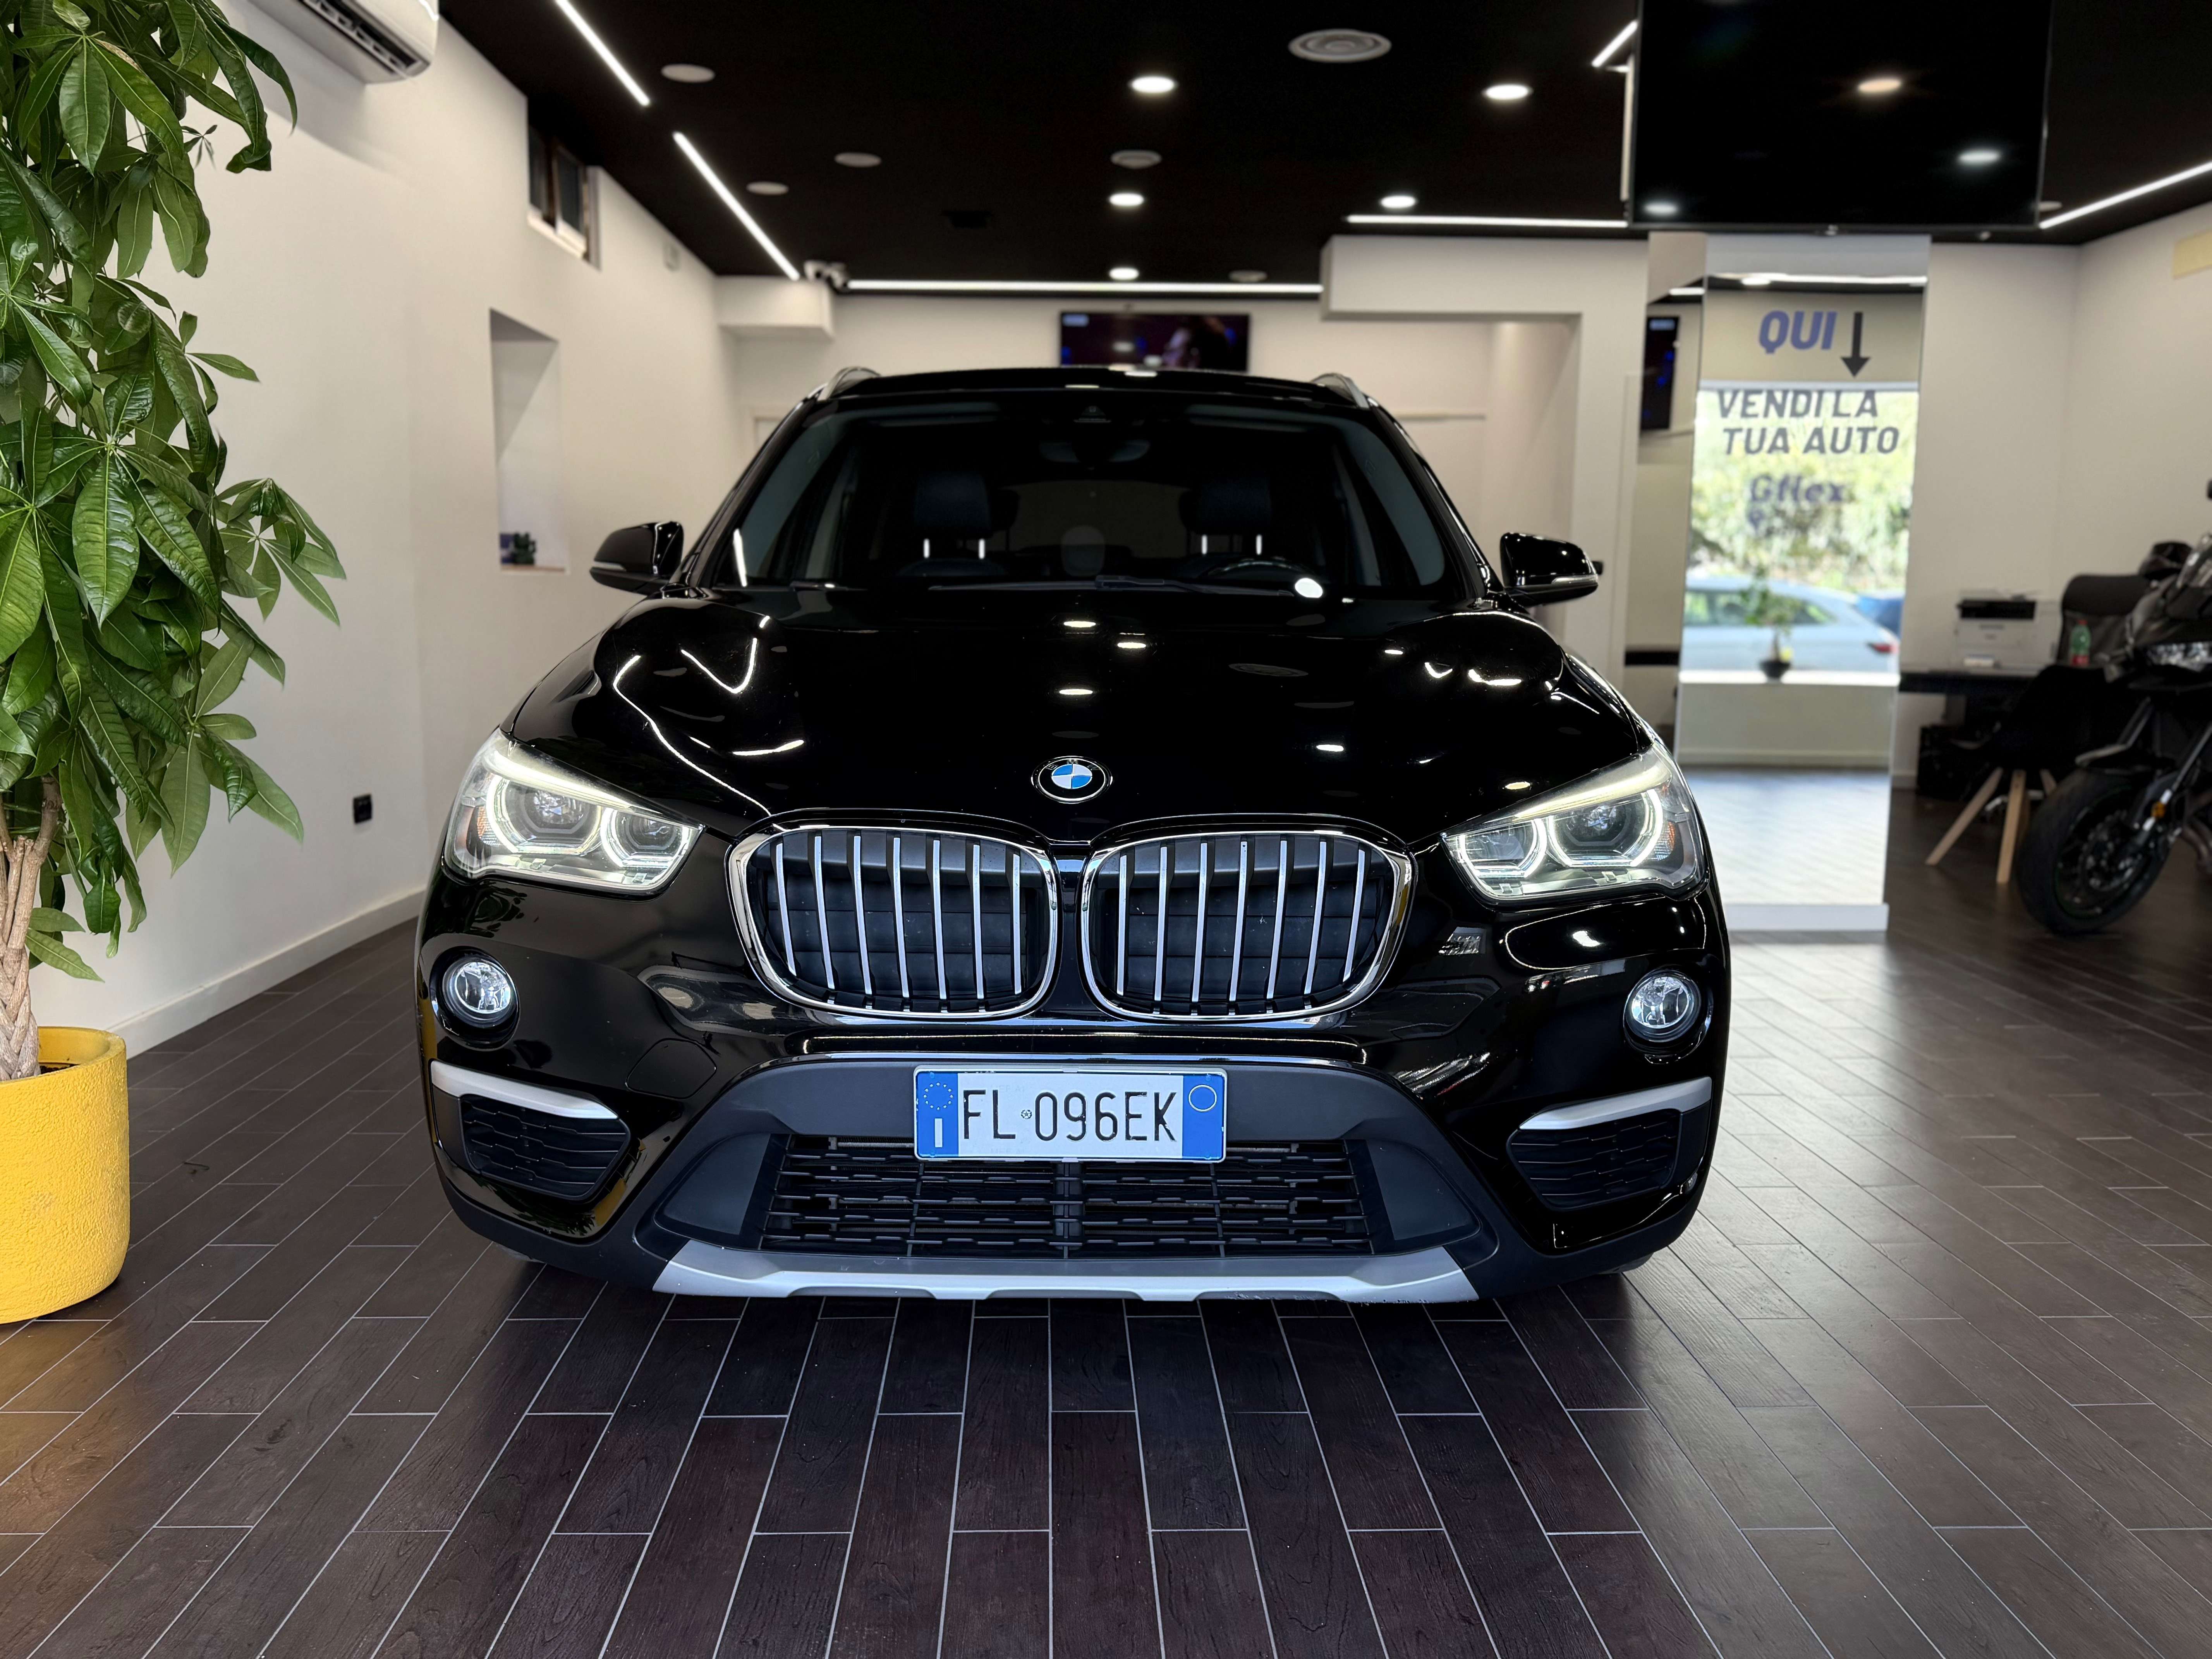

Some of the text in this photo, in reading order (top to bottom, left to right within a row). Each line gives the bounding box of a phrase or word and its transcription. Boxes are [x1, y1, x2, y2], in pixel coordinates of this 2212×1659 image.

[1758, 310, 1837, 354] QUI
[1717, 390, 1878, 418] VENDI LA
[1723, 427, 1900, 455] TUA AUTO
[963, 1089, 1177, 1142] FL 096EK
